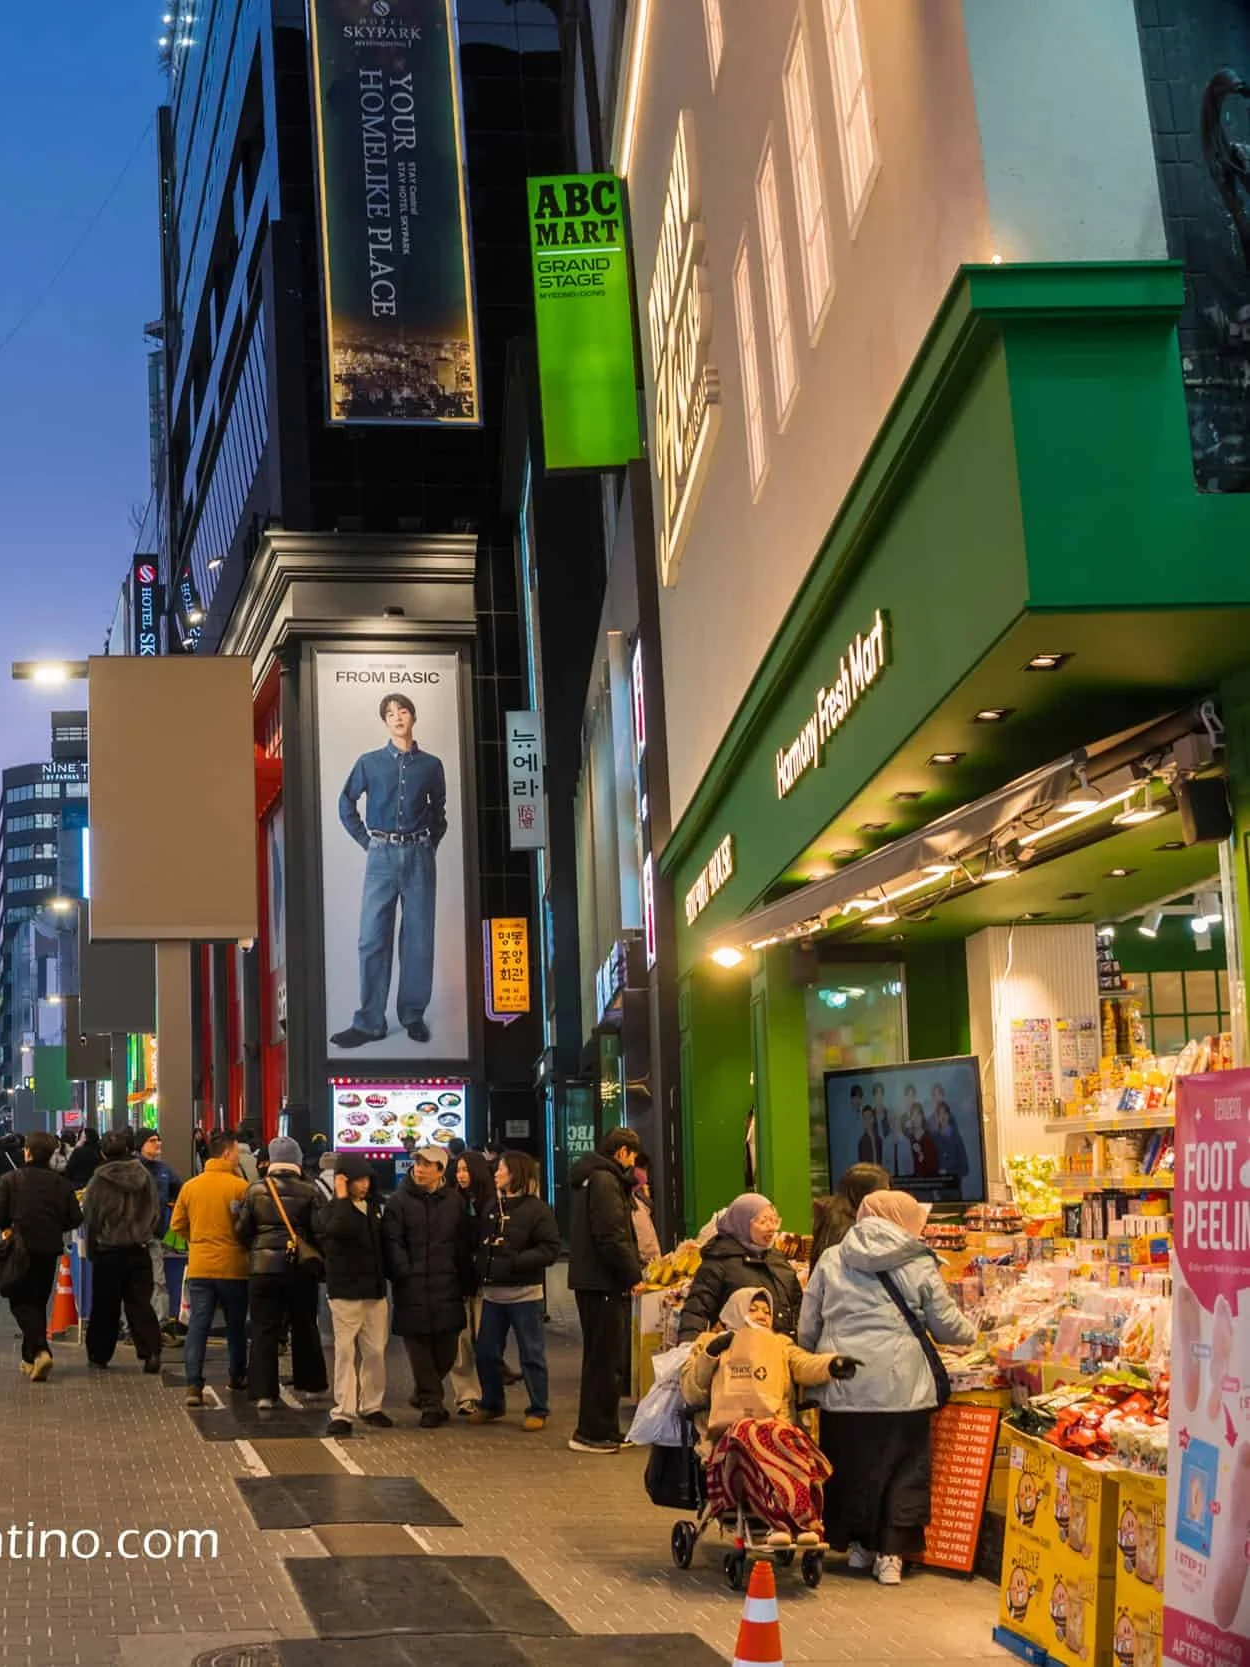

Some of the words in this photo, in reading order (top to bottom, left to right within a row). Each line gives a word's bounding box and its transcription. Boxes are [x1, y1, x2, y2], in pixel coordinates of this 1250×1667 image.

[343, 26, 422, 40] SKYPARK
[389, 73, 417, 153] YOUR
[359, 68, 391, 219] HOMELIKE
[397, 162, 408, 184] STAY
[534, 181, 617, 219] ABC
[535, 219, 619, 246] MART
[367, 226, 397, 318] PLACE
[537, 257, 610, 273] GRAND
[539, 273, 605, 289] STAGE
[141, 587, 153, 630] HOTEL
[336, 671, 385, 683] FROM
[389, 671, 440, 684] BASIC
[775, 711, 819, 801] Harmony
[816, 656, 852, 745] Fresh
[849, 608, 884, 700] Mart
[511, 729, 539, 798] 뉴에라
[1183, 1141, 1238, 1192] FOOT
